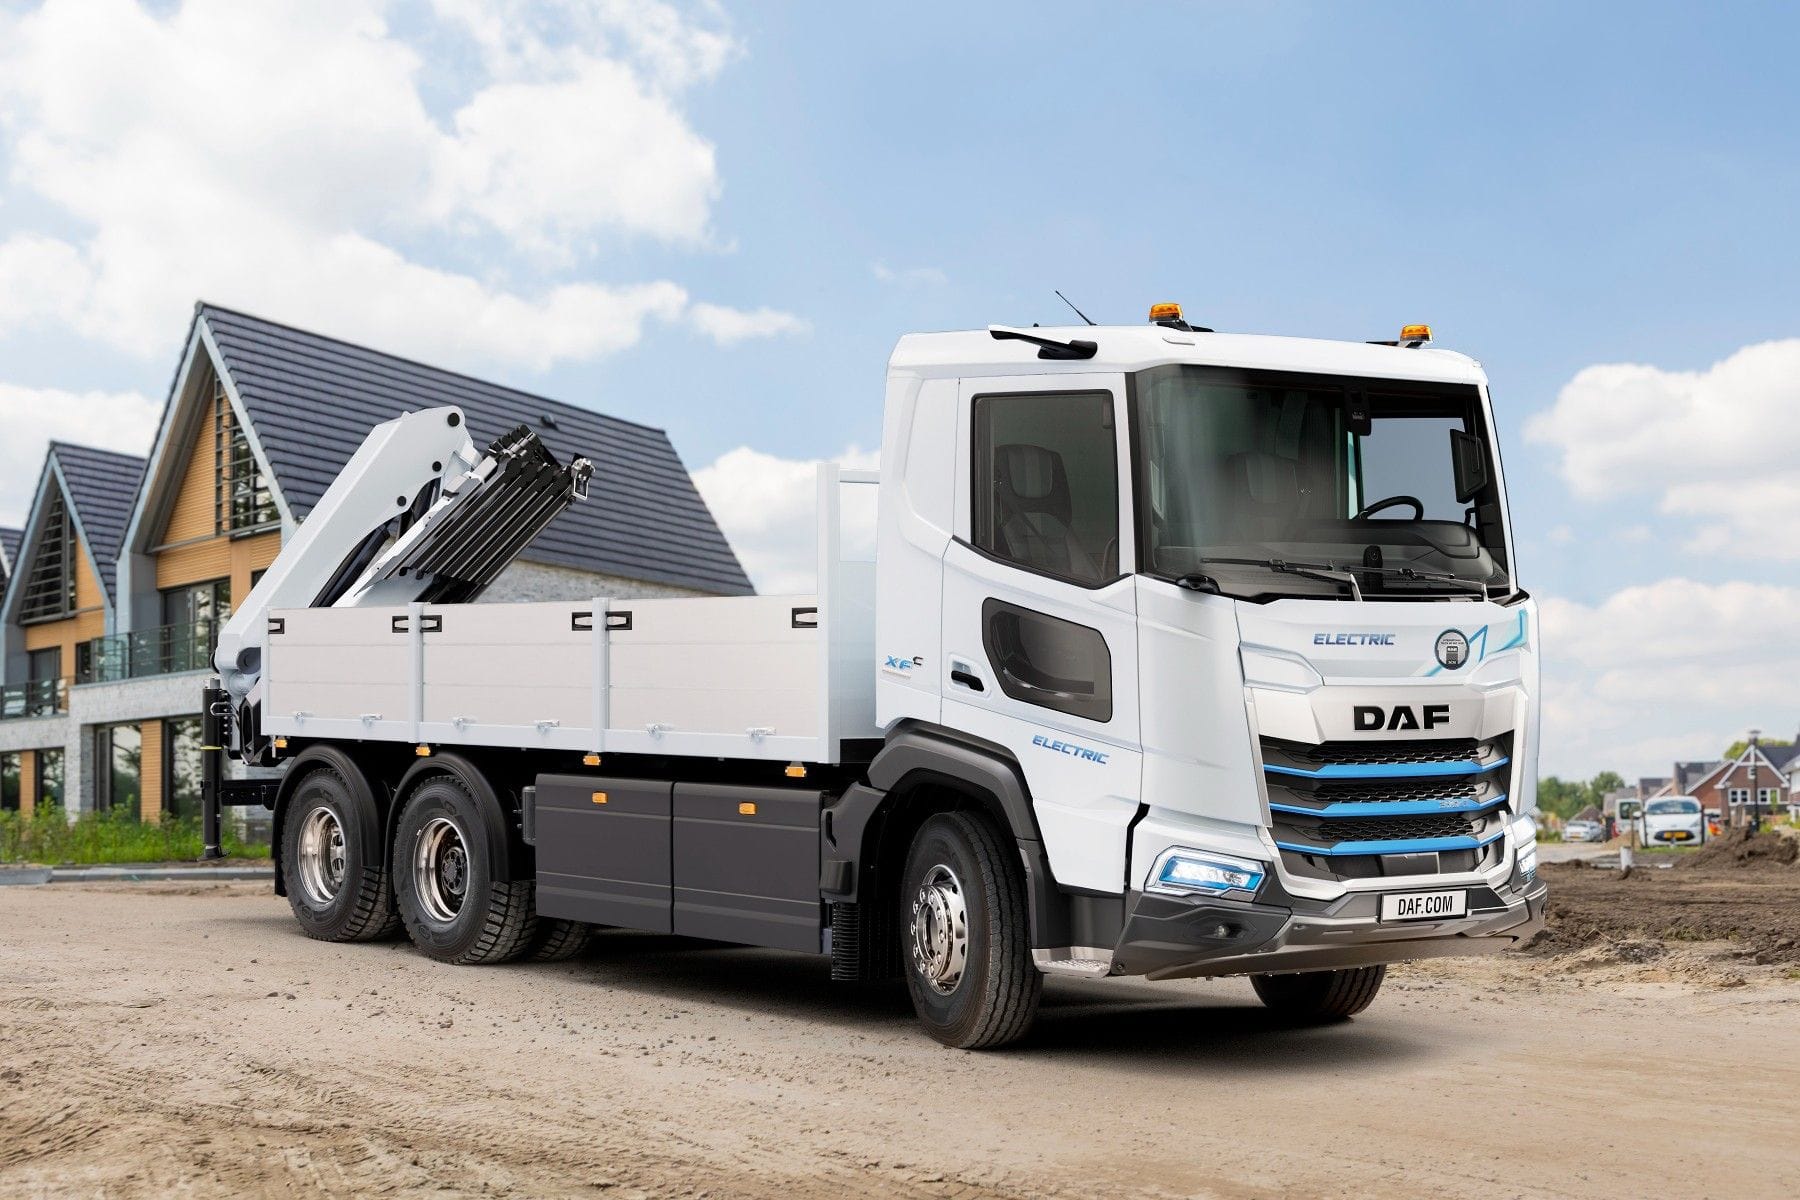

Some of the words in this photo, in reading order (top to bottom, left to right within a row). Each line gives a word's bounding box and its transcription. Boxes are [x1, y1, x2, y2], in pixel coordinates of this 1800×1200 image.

[1313, 633, 1396, 646] ELECTRIC
[1353, 704, 1450, 731] DAF
[1032, 734, 1110, 765] ELECTRIC
[1398, 895, 1453, 916] DAF.COM
